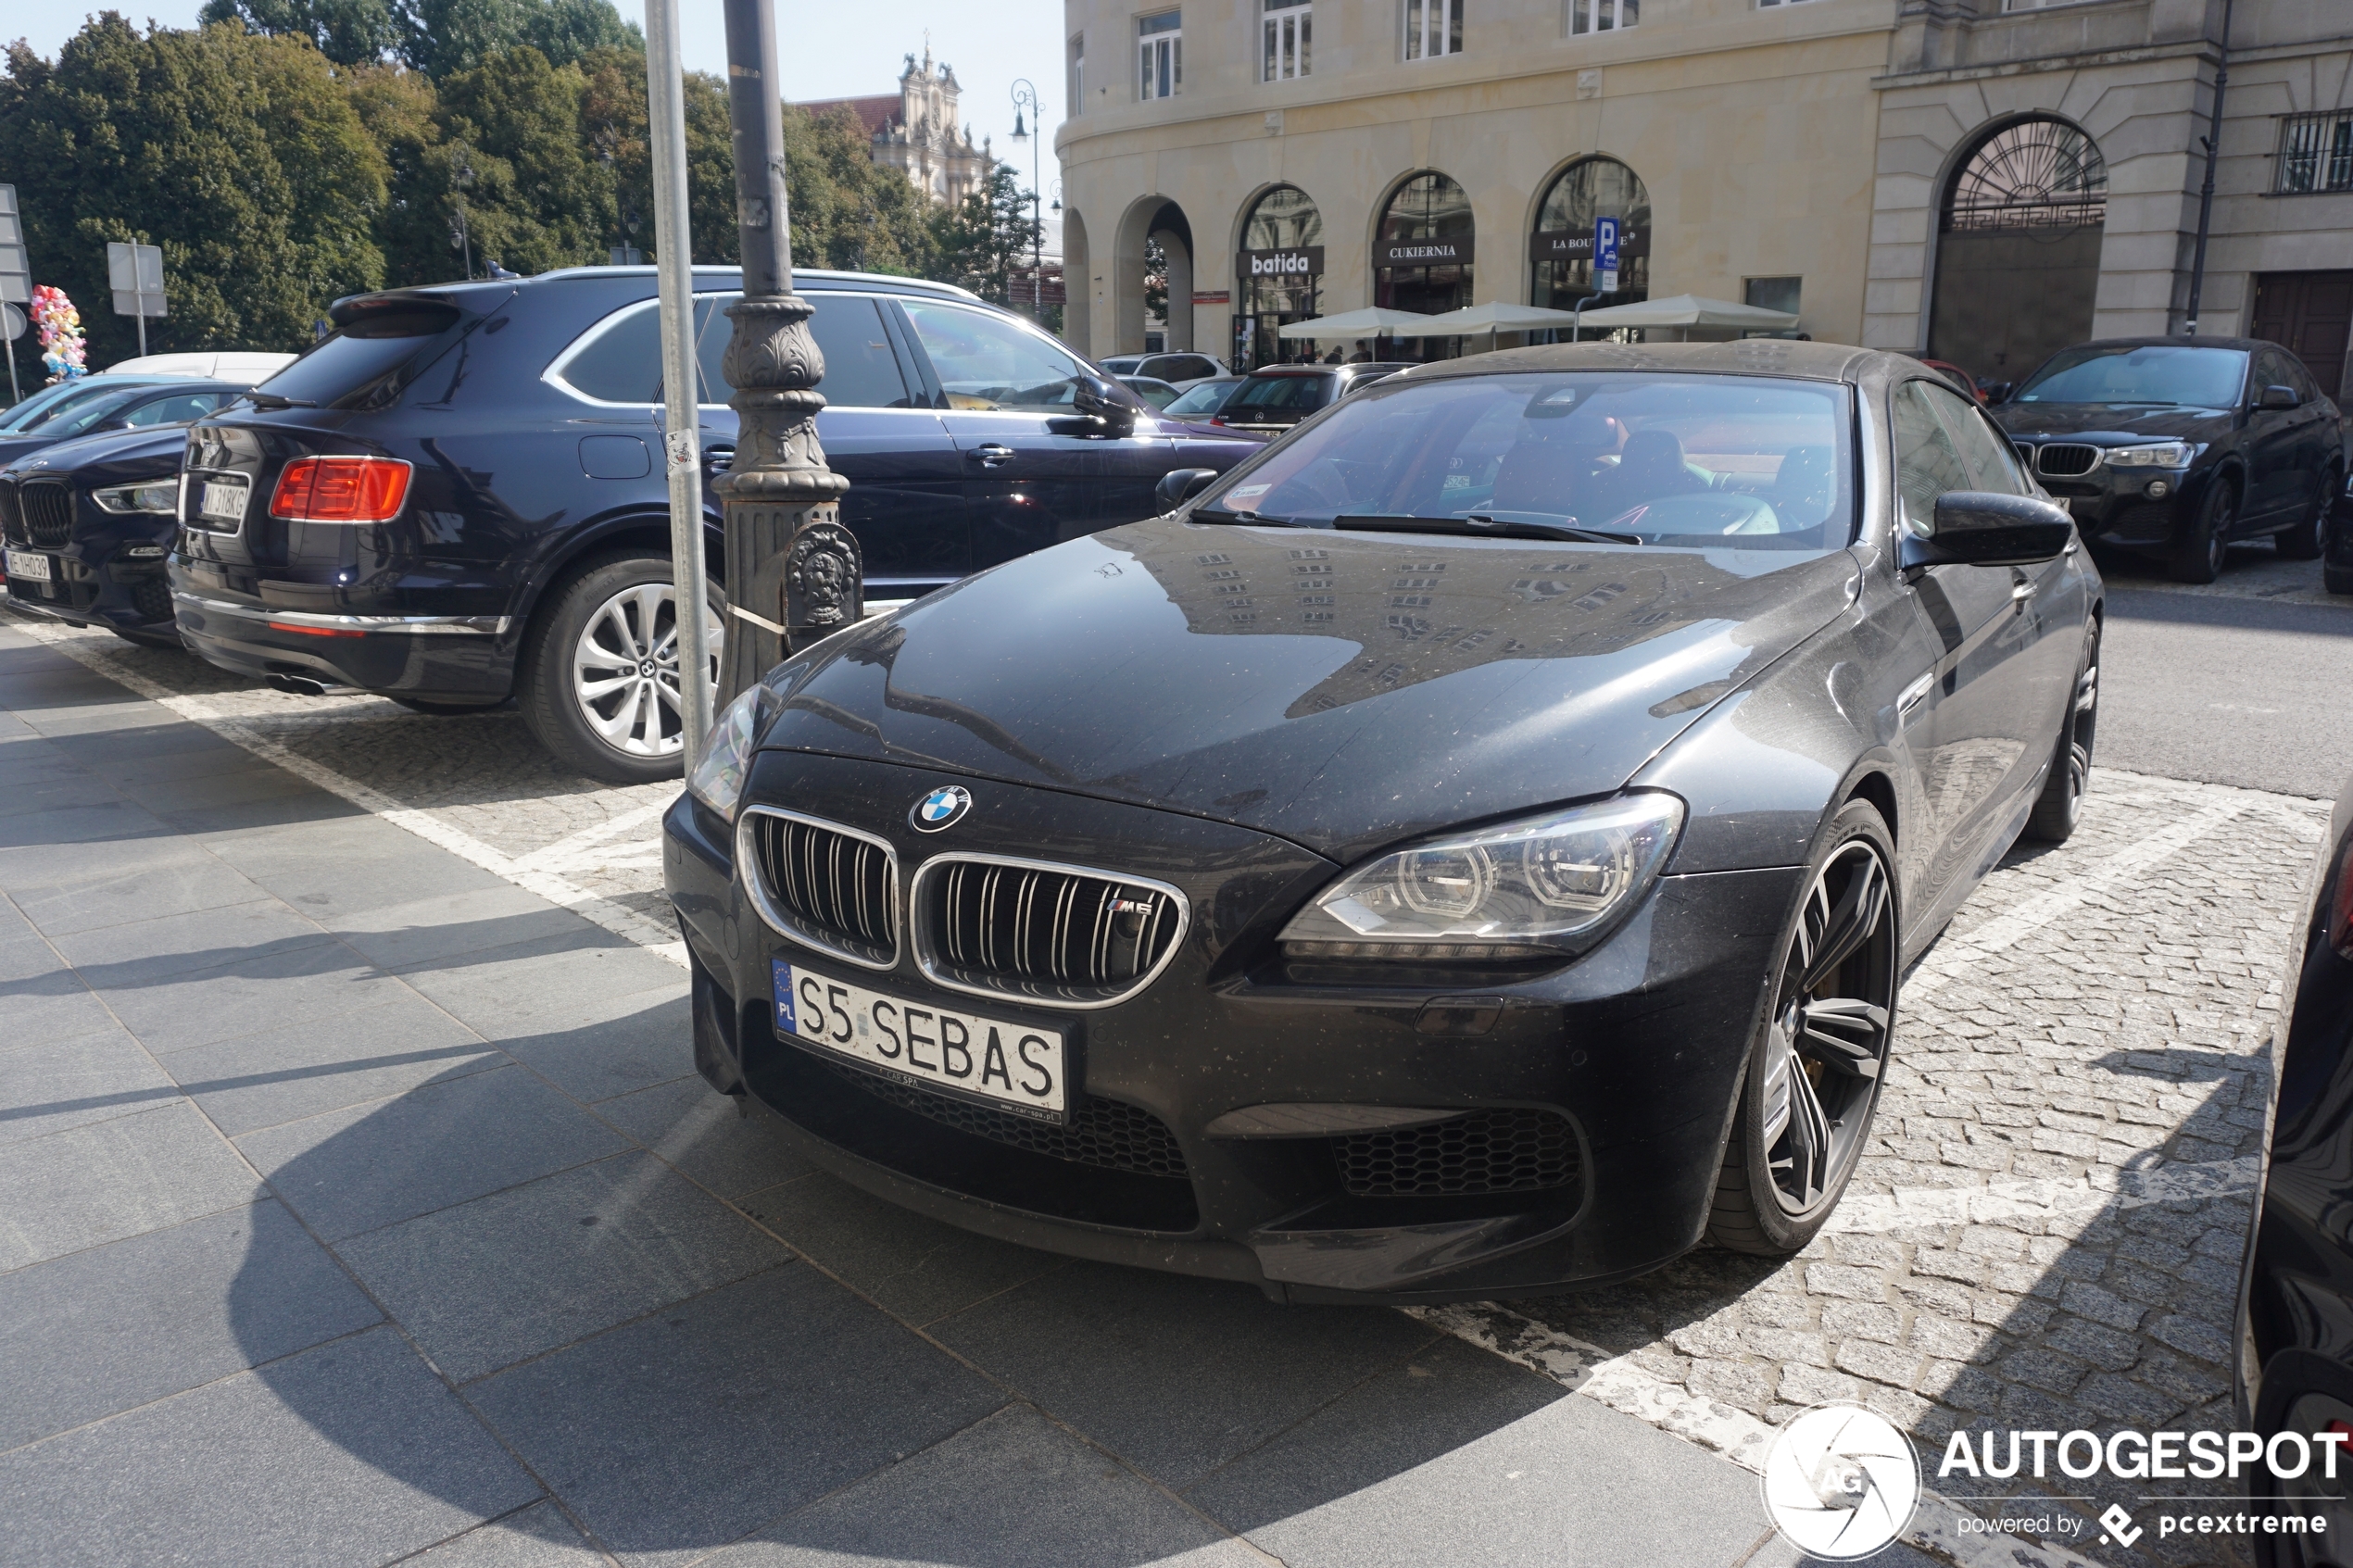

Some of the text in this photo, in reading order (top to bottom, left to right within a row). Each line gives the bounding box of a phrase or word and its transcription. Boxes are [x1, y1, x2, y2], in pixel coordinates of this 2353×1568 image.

[1553, 236, 1628, 249] LA BOUE
[1600, 221, 1615, 255] P
[1390, 245, 1456, 258] CUKIERNIA
[1252, 252, 1308, 273] batida
[215, 487, 245, 516] 318KG
[19, 555, 47, 577] 1H039
[1118, 899, 1152, 916] M6
[778, 1001, 794, 1021] PL
[799, 976, 1053, 1098] S5 SEBAS
[887, 1071, 919, 1087] CAR SPA
[1000, 1102, 1055, 1121] www.car-spa.pl
